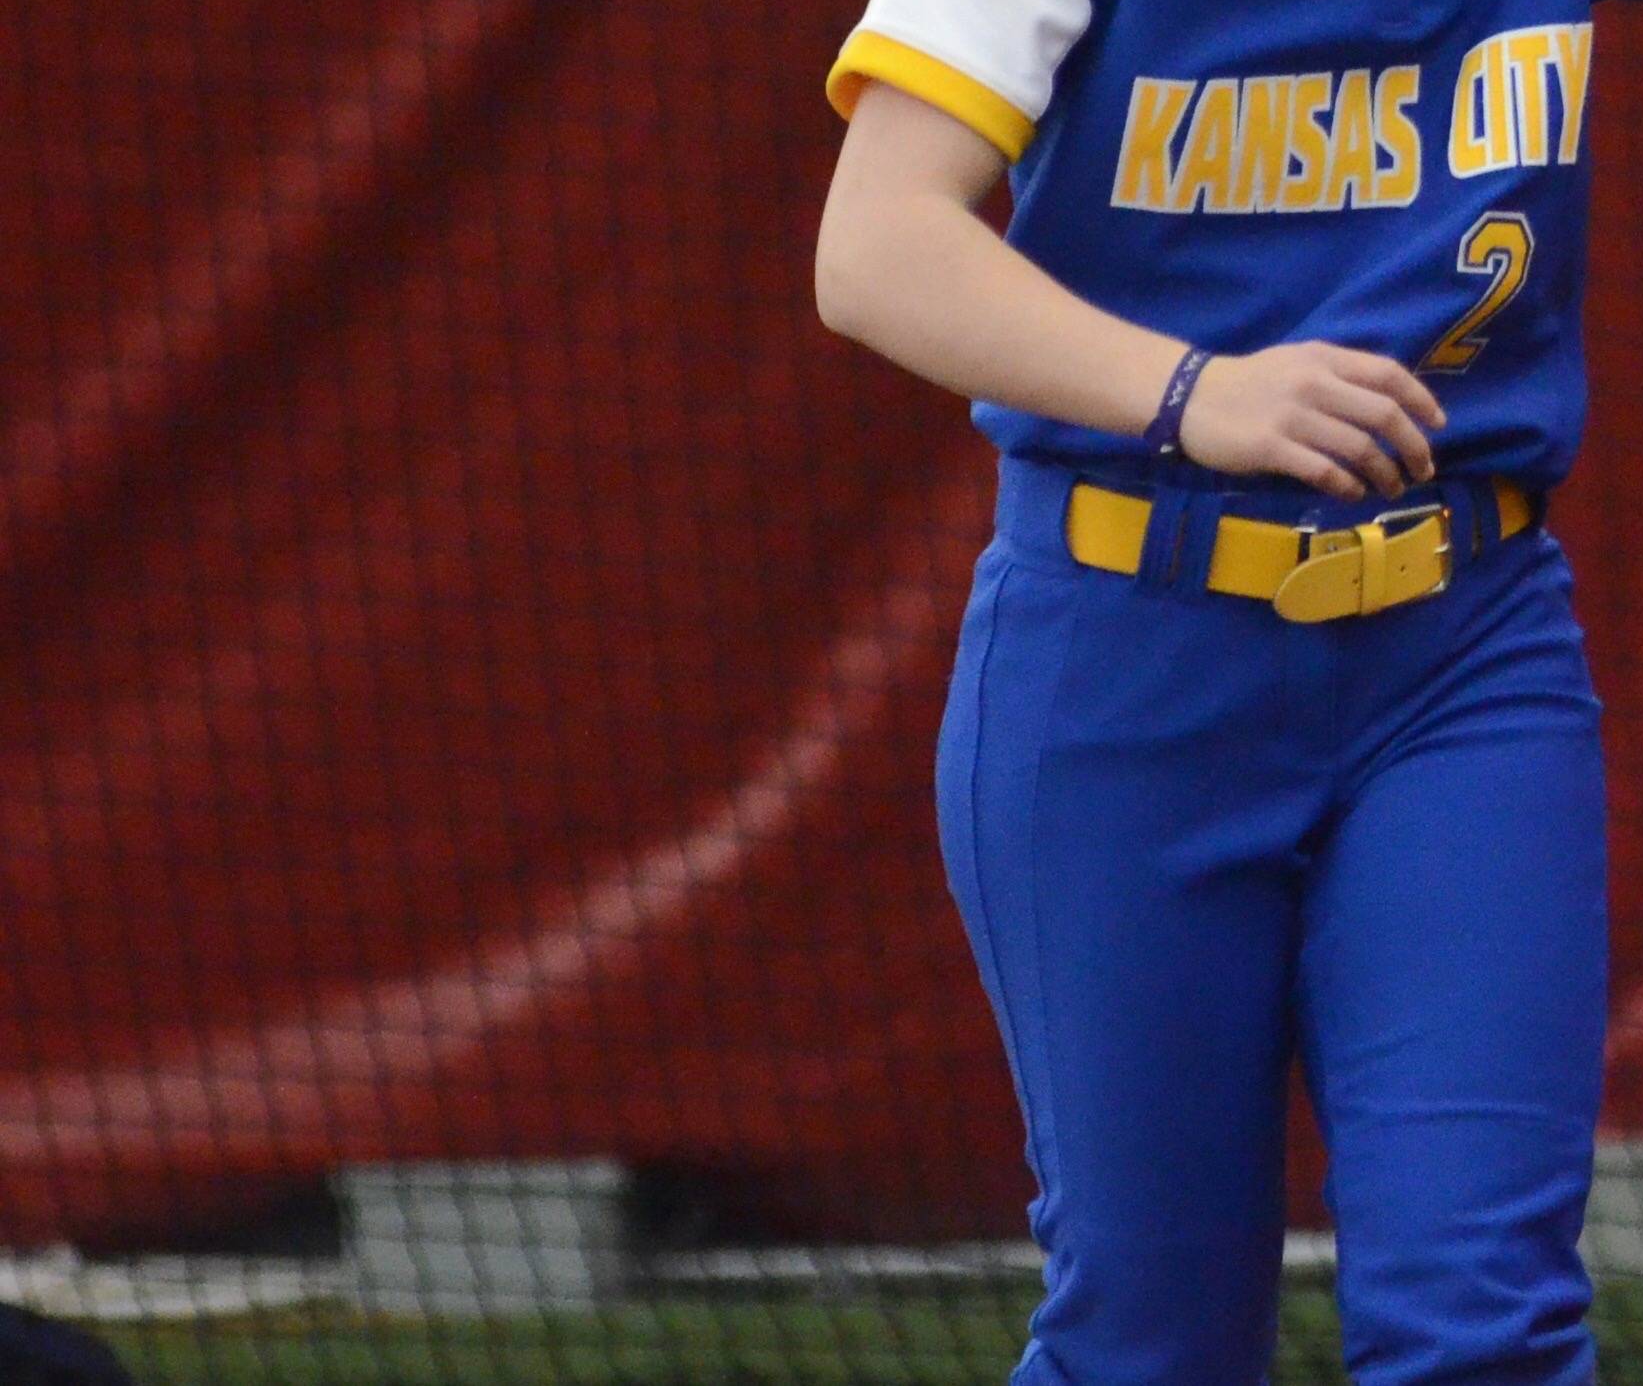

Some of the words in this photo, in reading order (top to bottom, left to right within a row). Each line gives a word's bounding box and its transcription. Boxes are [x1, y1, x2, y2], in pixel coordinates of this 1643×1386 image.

[1110, 63, 1421, 214] KANSAS
[1448, 21, 1594, 180] CITY
[1415, 210, 1534, 375] 2
